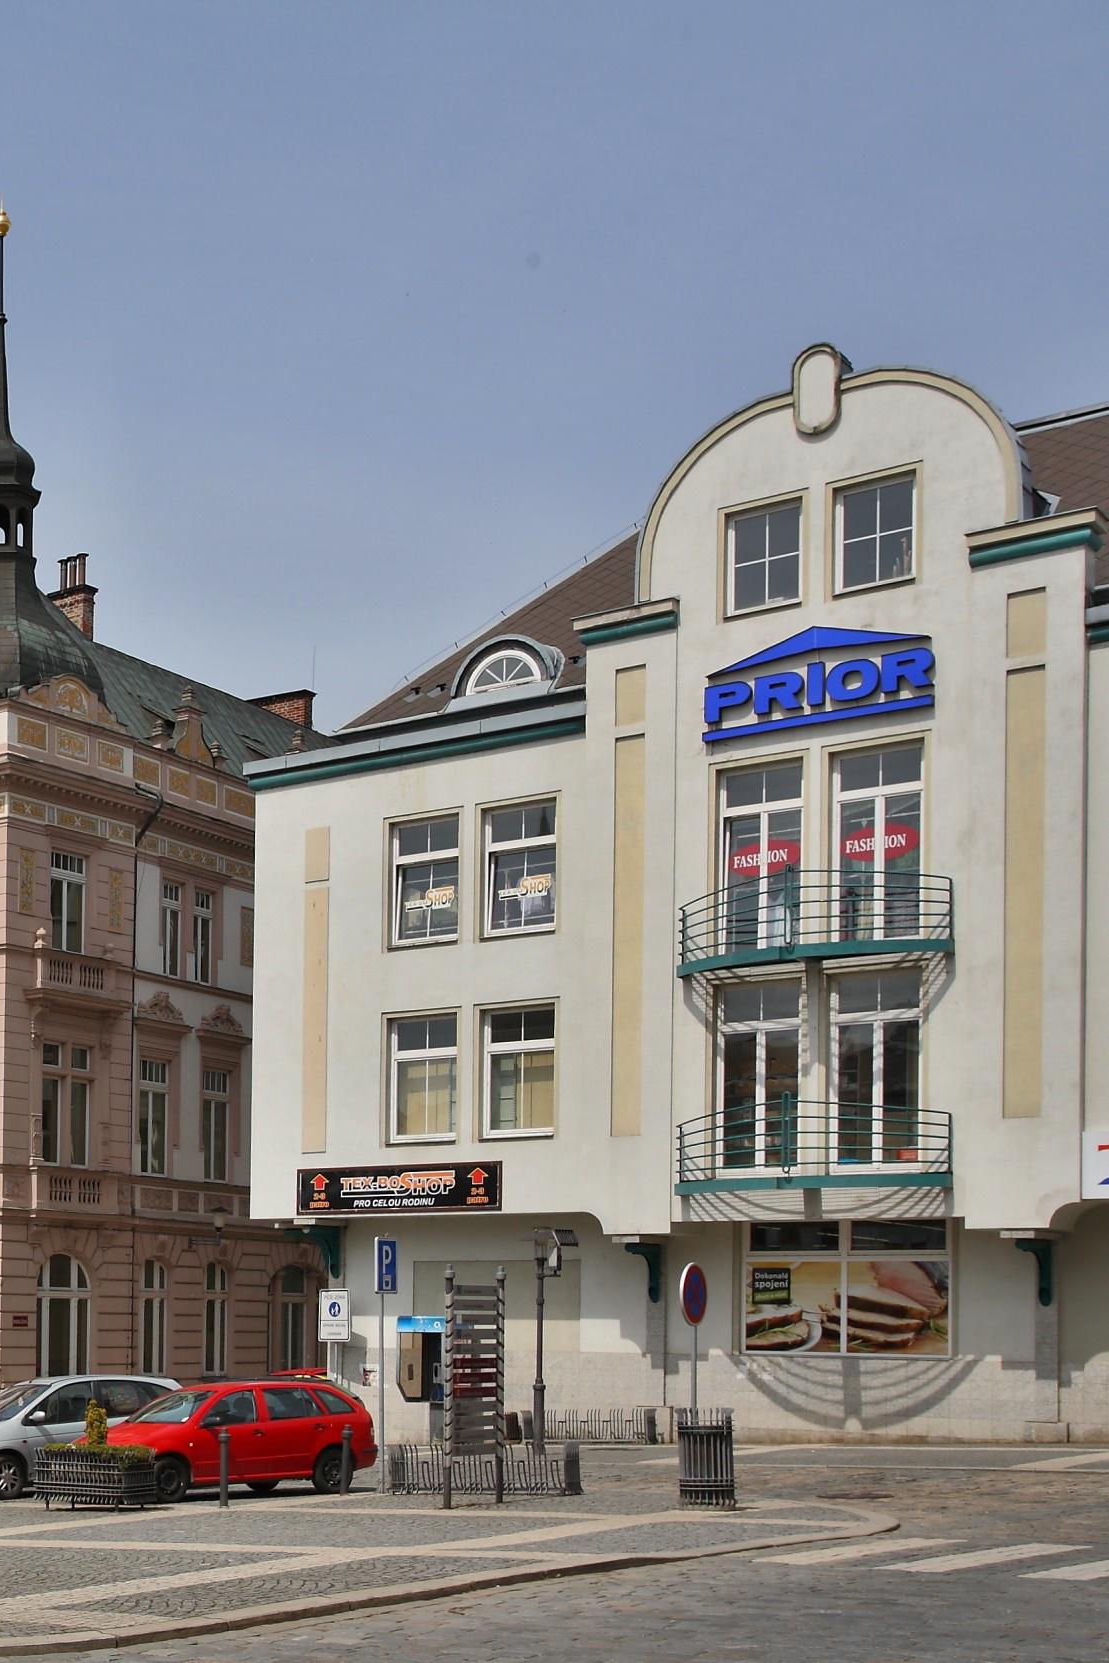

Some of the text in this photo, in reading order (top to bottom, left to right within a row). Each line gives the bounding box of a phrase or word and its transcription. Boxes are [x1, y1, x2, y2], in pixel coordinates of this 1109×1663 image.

[704, 648, 935, 724] PRIOR
[846, 833, 906, 854] FASHION
[733, 849, 788, 869] FASHION
[353, 1197, 435, 1208] PRO CELOU RODINU
[383, 1245, 392, 1275] P
[754, 1280, 789, 1289] spojení
